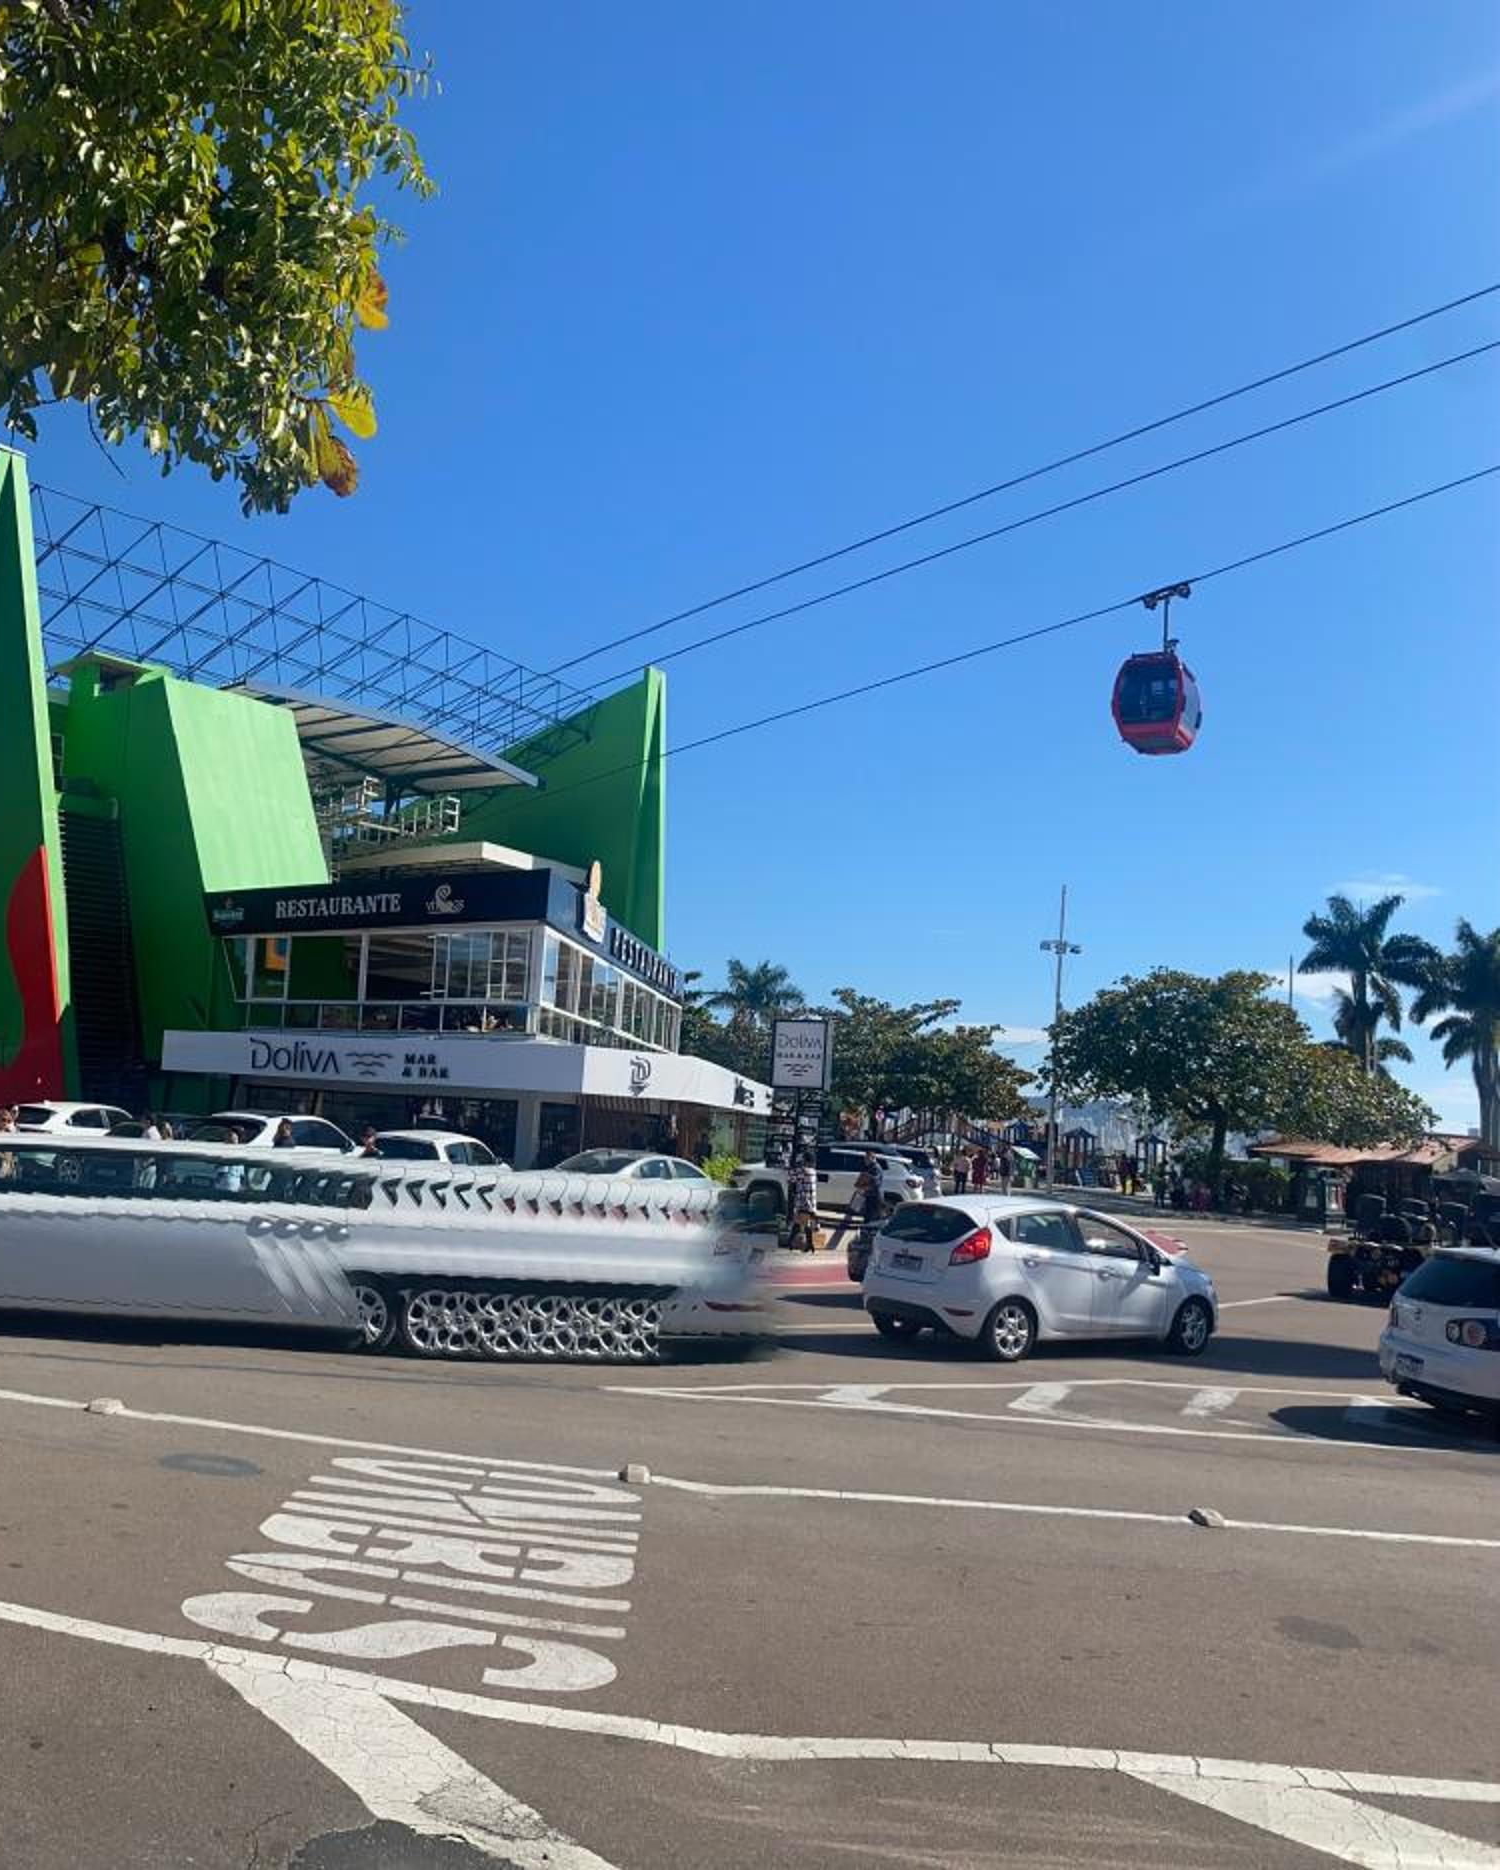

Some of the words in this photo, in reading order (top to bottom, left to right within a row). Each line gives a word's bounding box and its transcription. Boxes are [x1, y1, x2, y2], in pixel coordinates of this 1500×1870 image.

[275, 893, 402, 919] RESTAURANTE
[405, 1054, 437, 1065] MAR
[402, 1066, 412, 1077] &
[419, 1067, 449, 1079] BAR
